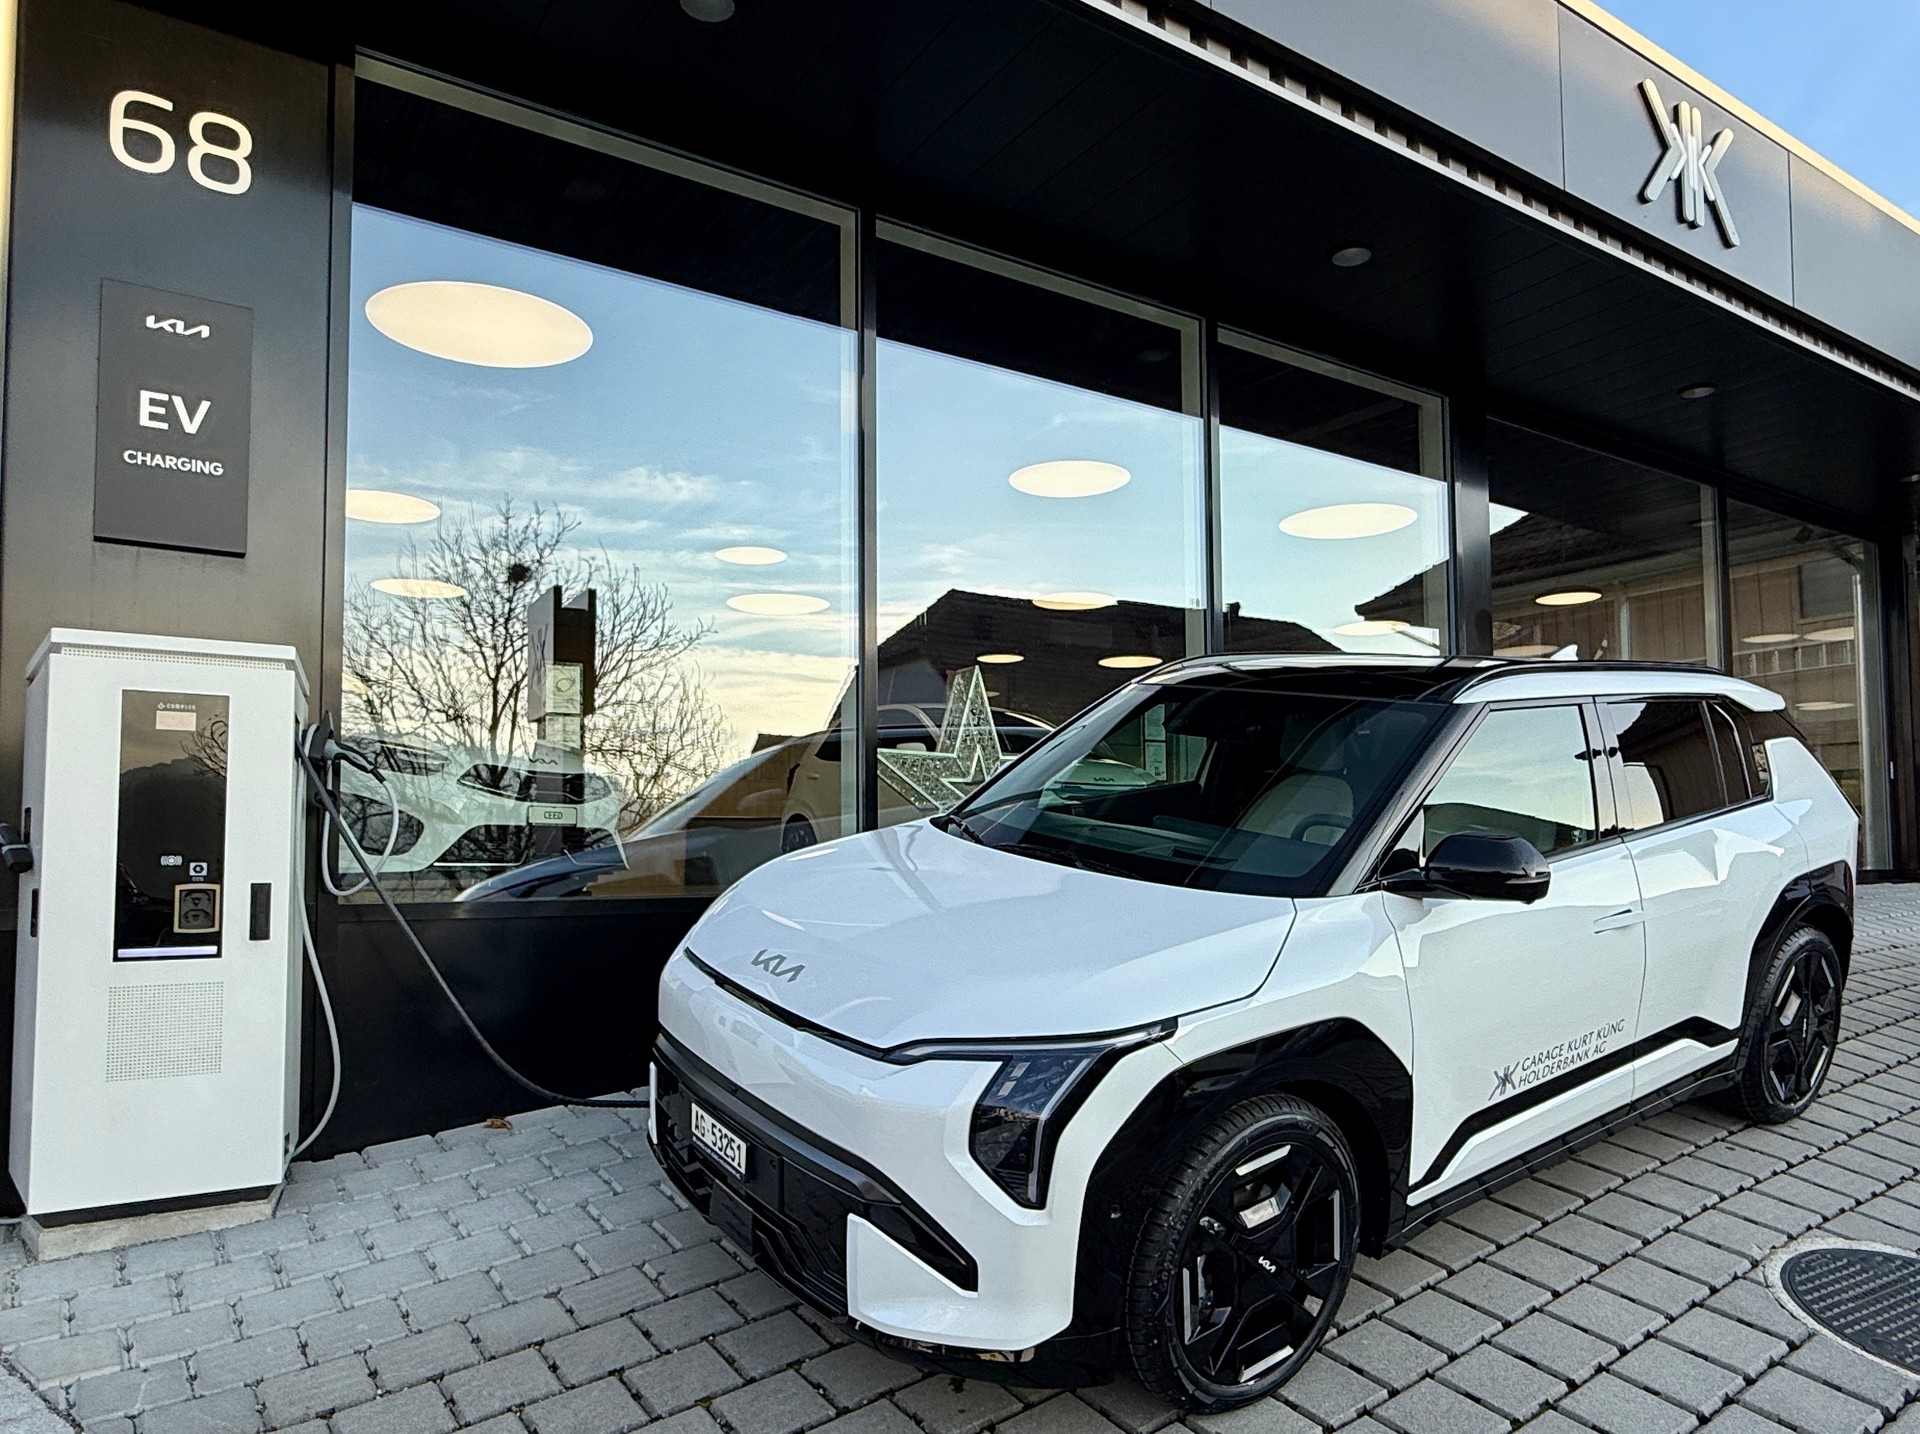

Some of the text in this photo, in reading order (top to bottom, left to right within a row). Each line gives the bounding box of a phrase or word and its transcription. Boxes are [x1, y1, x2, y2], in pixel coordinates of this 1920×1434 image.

[109, 89, 253, 195] 68
[146, 315, 210, 338] KIA
[139, 389, 212, 435] EV
[123, 449, 225, 476] CHARGING
[544, 811, 563, 820] CEED
[751, 948, 806, 983] KIA
[1518, 1040, 1608, 1088] HOLDERBANK AG
[1521, 1043, 1565, 1072] GARAGE
[1566, 1031, 1595, 1054] KURT
